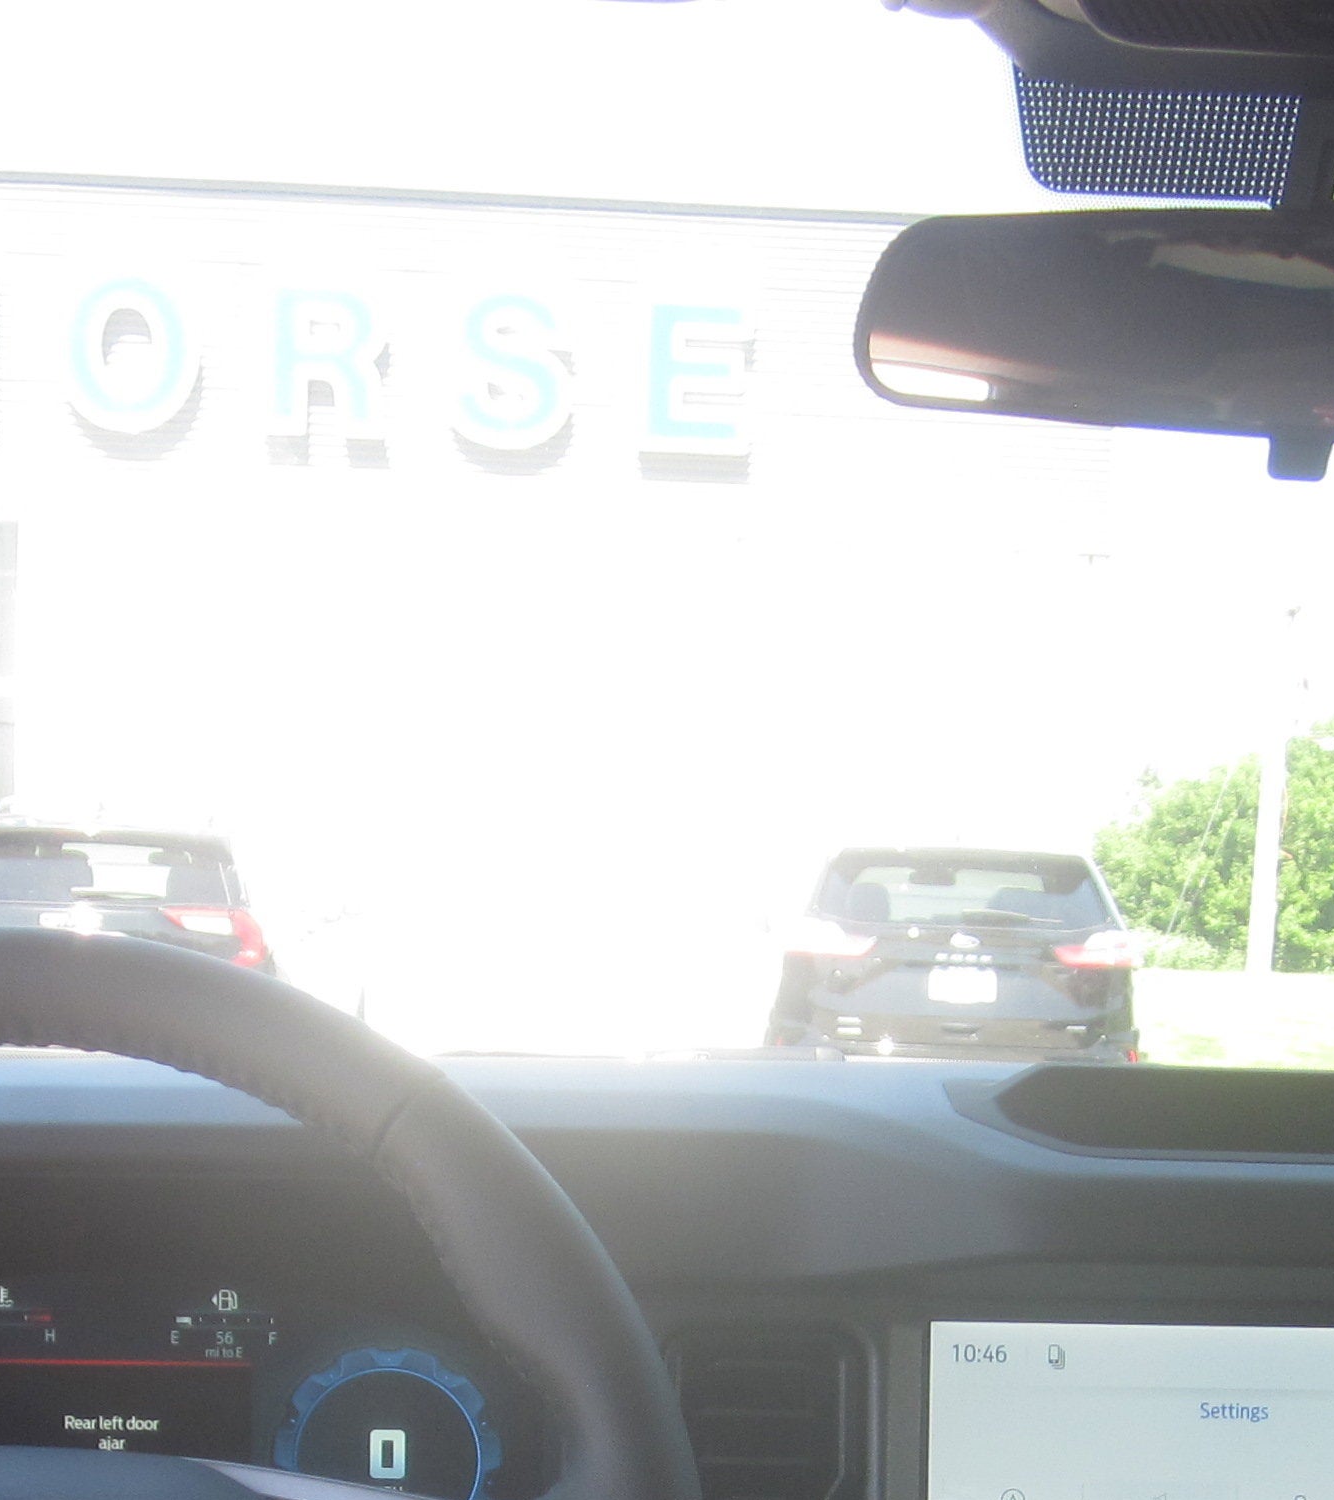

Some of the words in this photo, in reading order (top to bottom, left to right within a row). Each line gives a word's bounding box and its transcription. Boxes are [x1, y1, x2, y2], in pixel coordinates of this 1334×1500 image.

[44, 1328, 56, 1343] H
[169, 1330, 180, 1345] E
[215, 1330, 234, 1345] 56
[267, 1331, 278, 1346] F
[952, 1343, 1008, 1364] 10:46
[1199, 1401, 1270, 1423] Settings
[64, 1414, 98, 1432] Rear
[99, 1414, 124, 1432] left
[125, 1415, 160, 1432] door
[98, 1435, 126, 1451] ajar
[369, 1429, 406, 1479] 0
